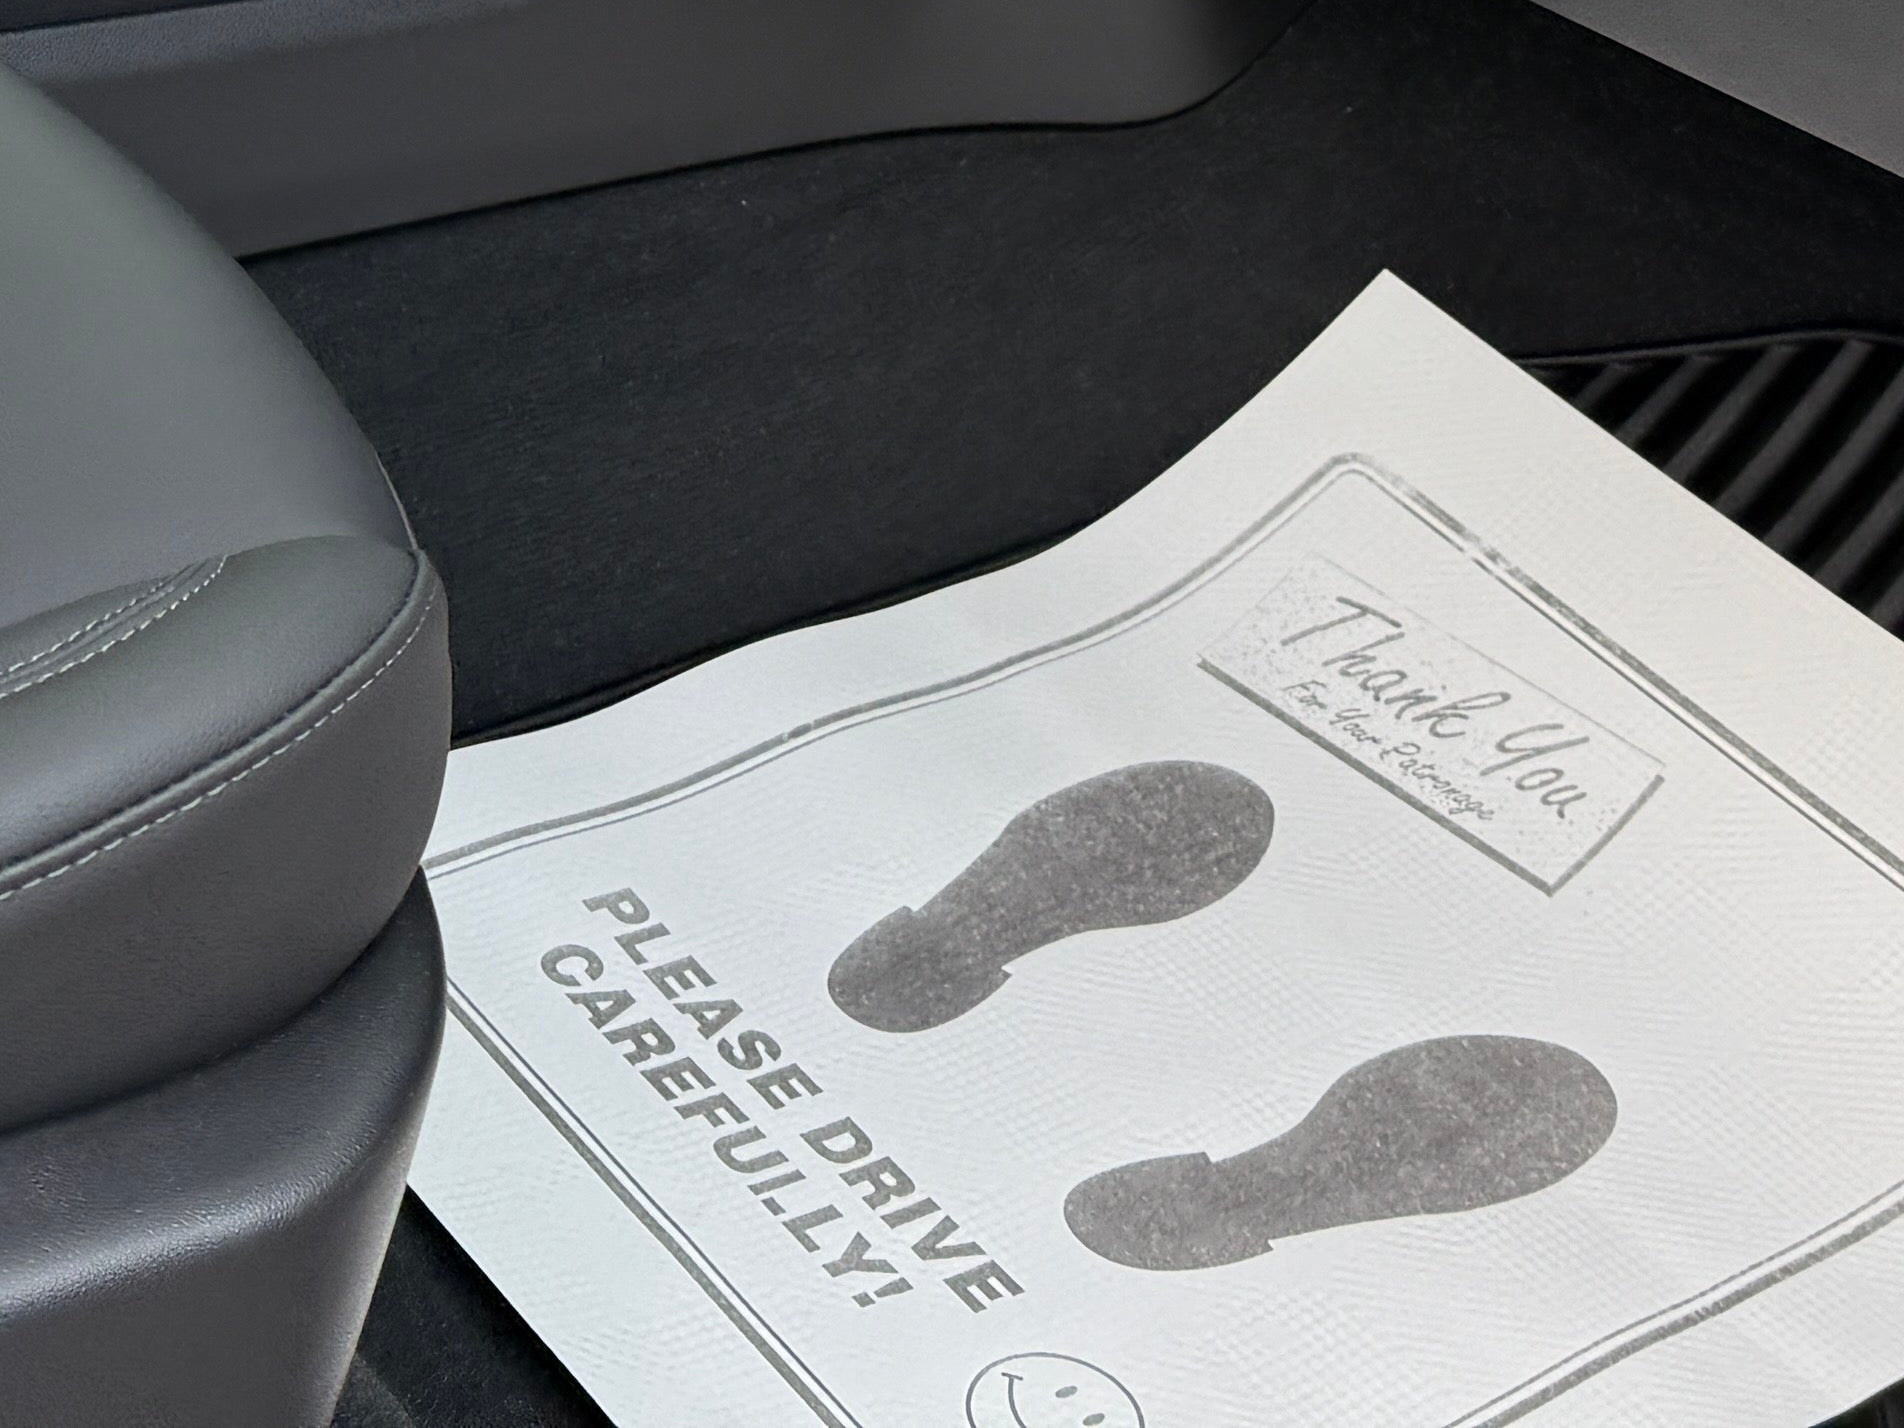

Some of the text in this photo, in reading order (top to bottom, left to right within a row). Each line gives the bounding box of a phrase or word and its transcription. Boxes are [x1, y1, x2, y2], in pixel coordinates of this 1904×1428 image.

[1280, 595, 1591, 819] Thank You
[1280, 679, 1496, 821] For Your Patronage
[540, 943, 914, 1309] CAREFULLY!
[582, 887, 1026, 1314] PLEASE DRIVE
